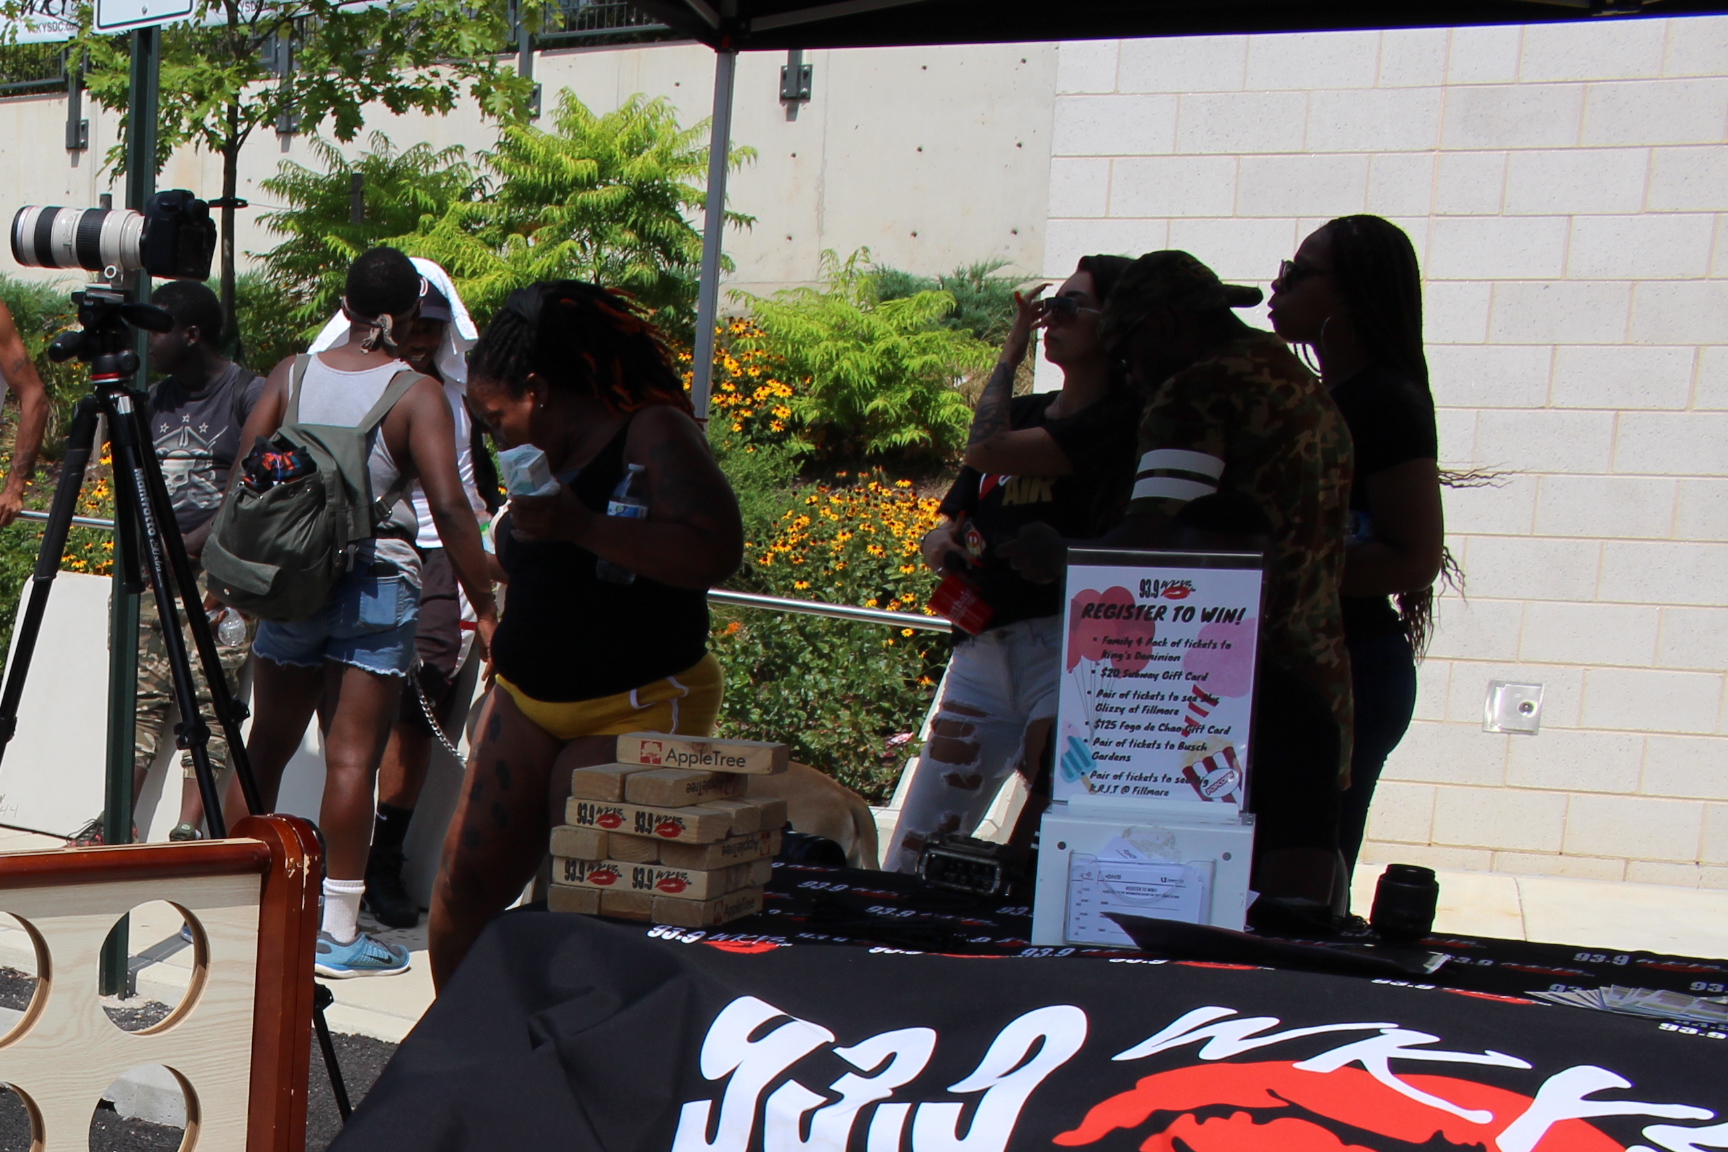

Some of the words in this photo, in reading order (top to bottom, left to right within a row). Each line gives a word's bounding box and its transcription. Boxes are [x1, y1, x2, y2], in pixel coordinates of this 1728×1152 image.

[134, 467, 157, 537] Manfrotto
[1139, 578, 1160, 599] 93.9
[1081, 602, 1167, 622] REGISTER
[1172, 605, 1195, 623] TO
[1200, 607, 1247, 626] WIN!
[1102, 636, 1133, 648] Family
[1136, 637, 1143, 646] 4
[1145, 637, 1168, 648] Pack
[1171, 638, 1182, 648] of
[1183, 639, 1217, 650] tickets
[1220, 642, 1232, 650] to
[1101, 649, 1131, 662] King's
[1134, 651, 1181, 662] Dominion
[1100, 667, 1120, 678] $20
[1122, 668, 1160, 682] Subway
[1161, 670, 1183, 681] Gift
[1185, 672, 1209, 682] Card
[1096, 689, 1117, 699] Pair
[1118, 690, 1130, 699] of
[1132, 691, 1165, 701] tickets
[1168, 692, 1179, 701] to
[1181, 694, 1198, 703] see
[1095, 703, 1124, 715] Glizzy
[1128, 705, 1140, 714] at
[1141, 704, 1180, 716] Fillmore
[1093, 719, 1117, 731] $125
[1119, 721, 1142, 733] Fogo
[1143, 722, 1156, 732] de
[1157, 723, 1183, 733] Chao
[1184, 724, 1206, 734] Gift
[1207, 725, 1232, 735] Card
[1092, 737, 1113, 748] Pair
[1115, 738, 1128, 748] of
[1128, 739, 1162, 750] tickets
[1164, 741, 1175, 750] to
[1177, 741, 1208, 752] Busch
[665, 747, 747, 768] AppleTree
[1091, 752, 1132, 762] Gardens
[1089, 770, 1110, 781] Pair
[1112, 771, 1125, 781] of
[1125, 772, 1159, 783] tickets
[1161, 774, 1172, 783] to
[1174, 775, 1191, 785] see
[1204, 770, 1235, 796] POPCORN
[1120, 784, 1131, 795] @
[1132, 786, 1170, 797] Fillmore
[576, 802, 595, 826] 93.9
[634, 810, 654, 835] 93.9
[564, 859, 585, 883] 93.9
[632, 866, 654, 891] 93.9
[797, 880, 851, 893] 93.9
[865, 904, 917, 919] 93.9
[996, 906, 1034, 918] 93.
[646, 924, 707, 945] 93.9
[1021, 946, 1076, 959] 93.9
[1573, 952, 1631, 966] 93.9
[1658, 1022, 1728, 1040] 93.9
